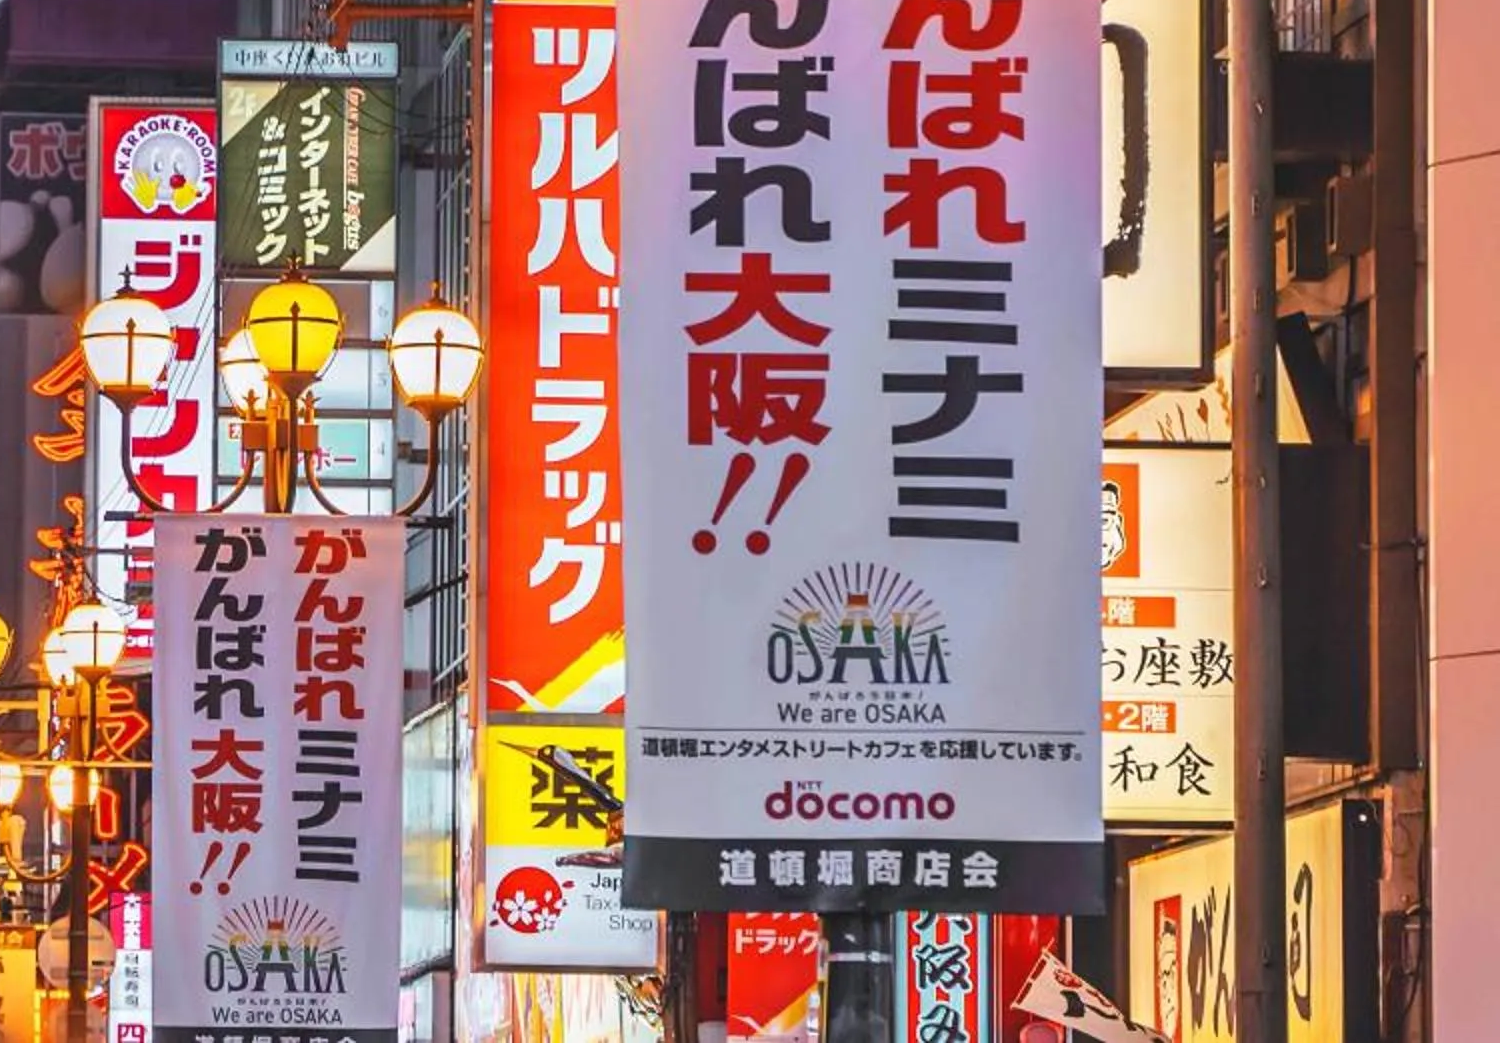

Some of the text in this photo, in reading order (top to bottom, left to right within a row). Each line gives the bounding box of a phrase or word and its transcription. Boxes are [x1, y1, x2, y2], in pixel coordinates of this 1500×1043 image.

[298, 86, 332, 266] インターネット
[527, 28, 622, 625] ツルハドラッグ
[1103, 598, 1137, 625] 階
[292, 528, 367, 883] がんばれミナミ
[777, 702, 946, 724] We are OSAKA
[531, 746, 615, 830] 薬
[1110, 742, 1215, 797] 和食
[764, 780, 956, 821] docomo
[590, 873, 623, 892] Jap
[720, 849, 1000, 888] 道頓堀商店会
[609, 916, 653, 932] Shop
[212, 1006, 343, 1025] We are OSAKA
